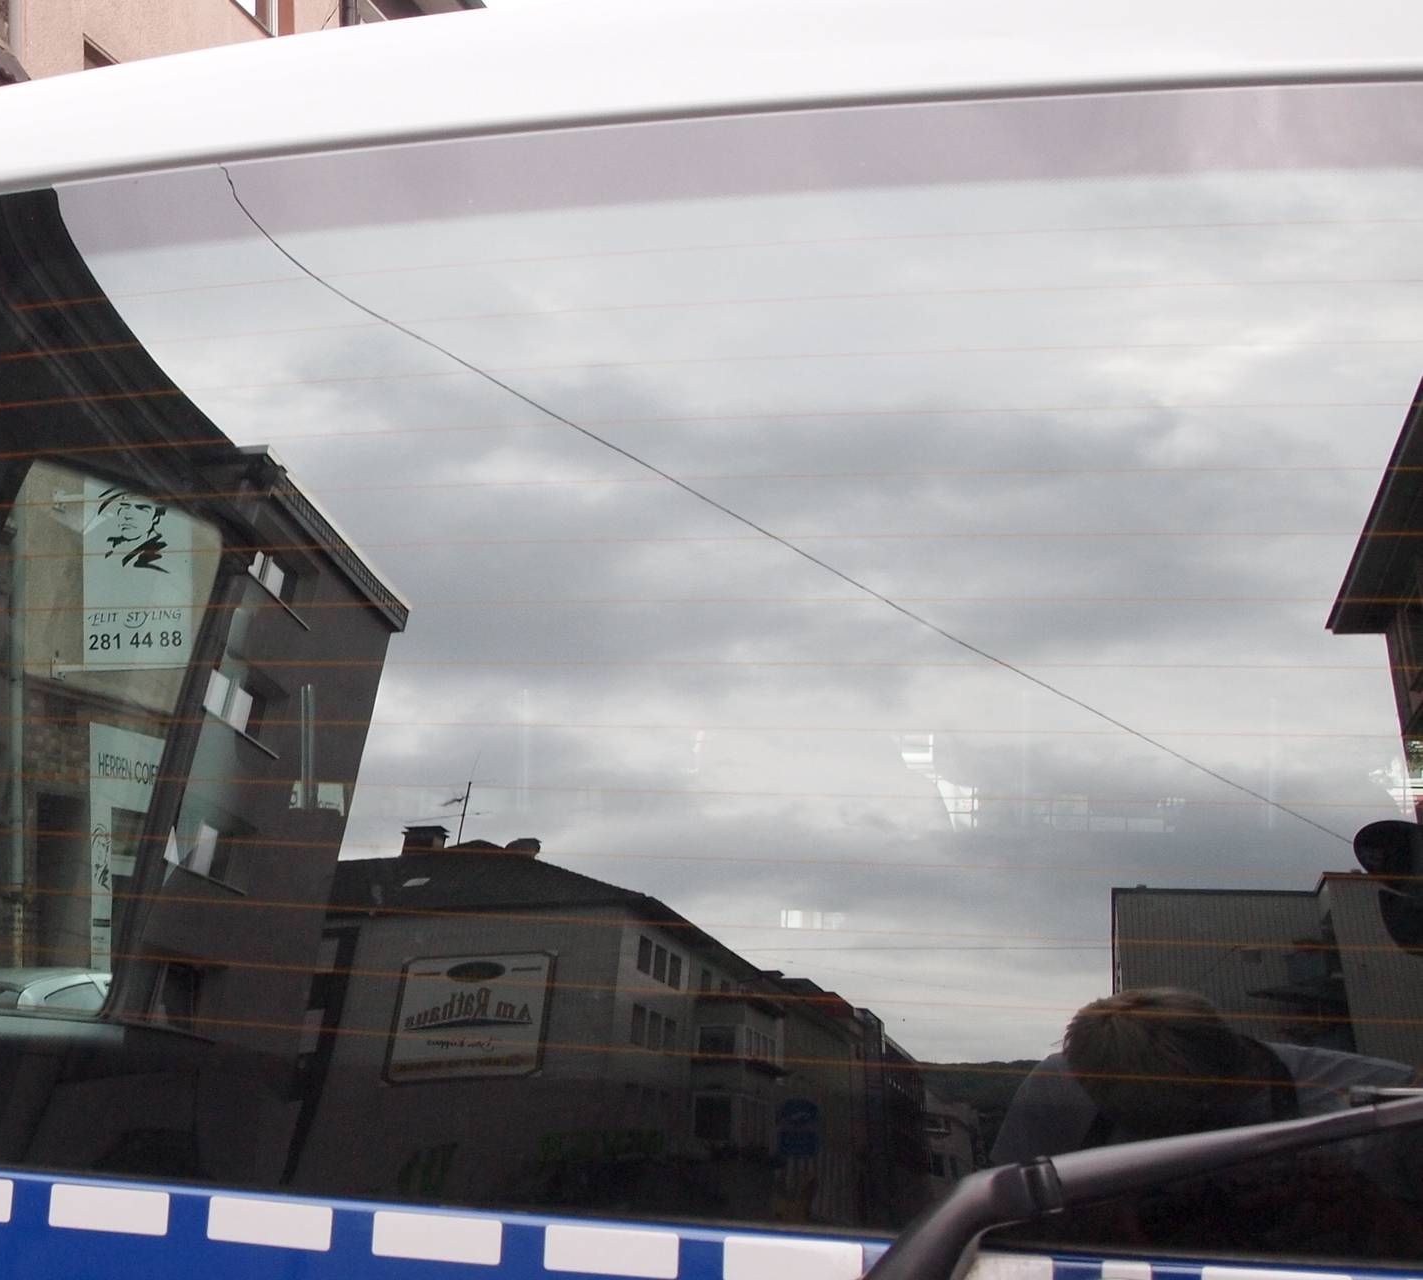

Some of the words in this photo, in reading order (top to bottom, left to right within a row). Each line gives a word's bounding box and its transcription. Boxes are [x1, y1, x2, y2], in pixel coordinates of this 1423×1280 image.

[124, 609, 181, 628] STYLING
[89, 633, 120, 650] 281
[130, 632, 153, 648] 44
[160, 631, 182, 647] 88
[98, 752, 132, 780] HERREN
